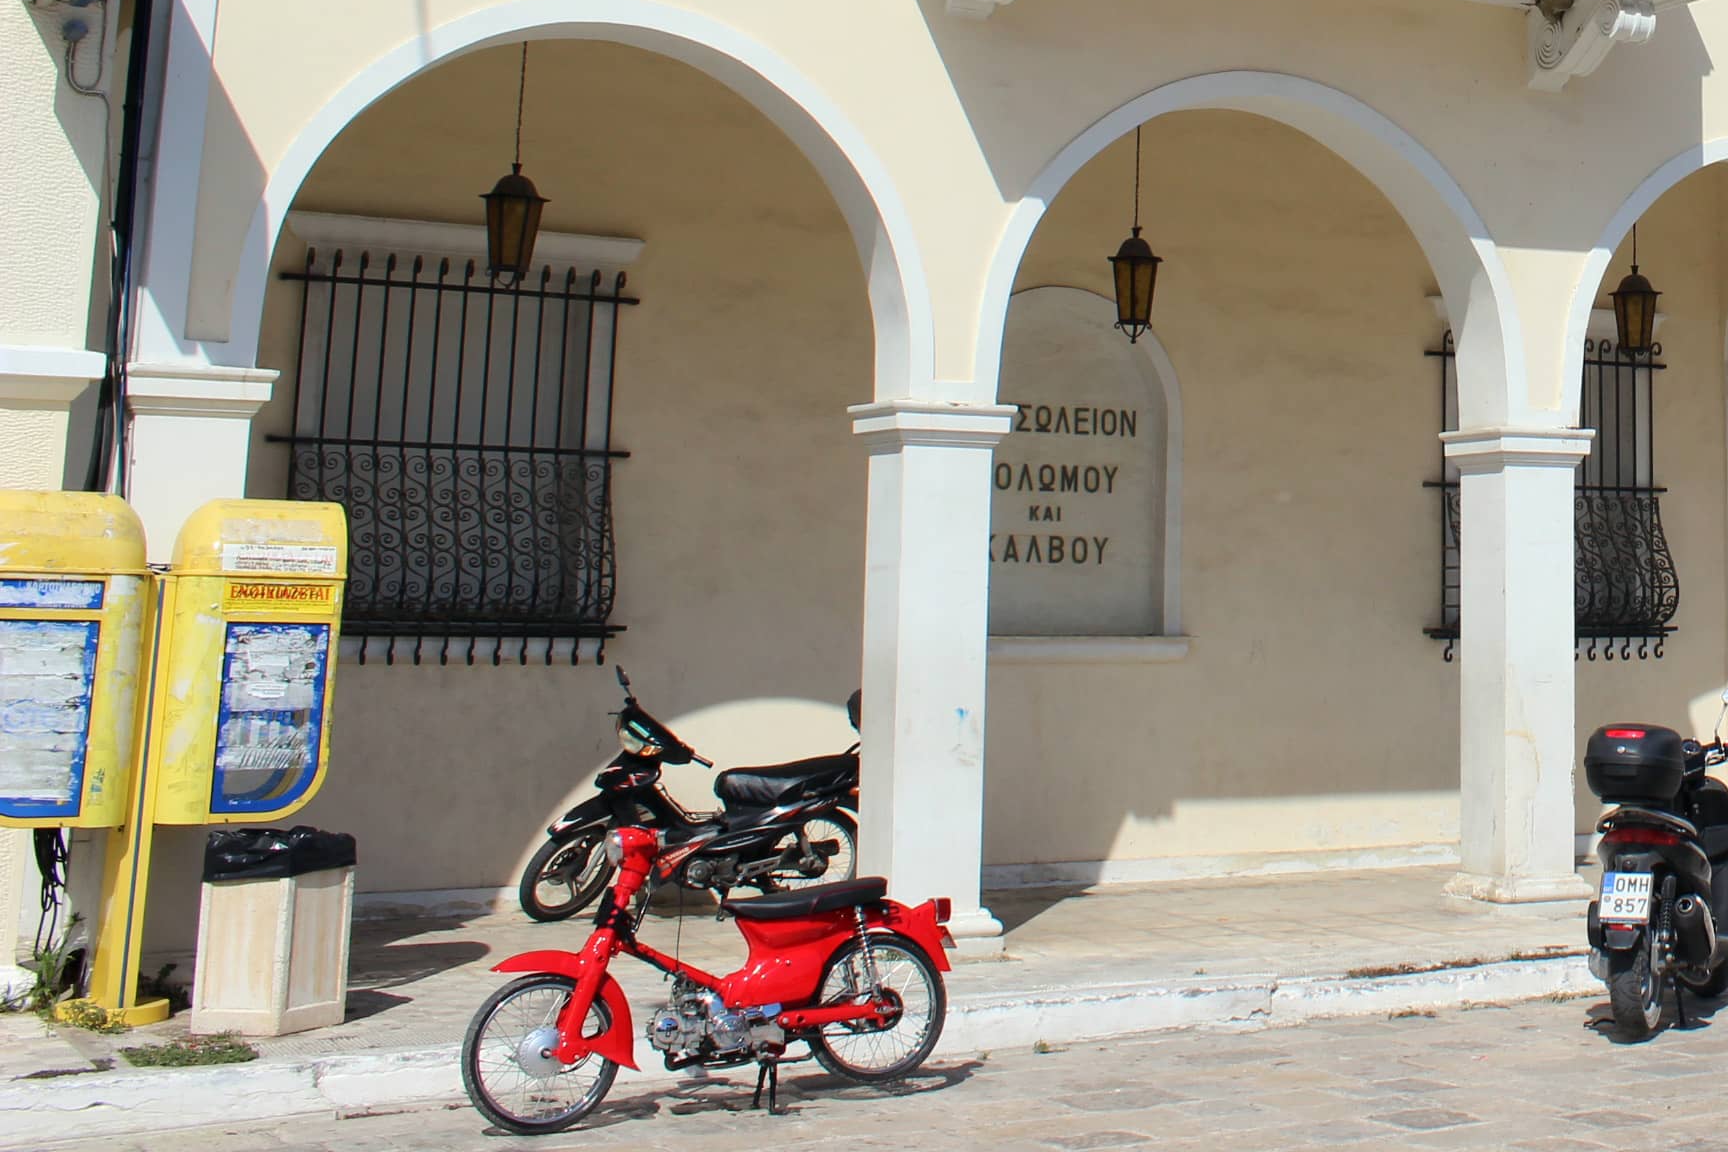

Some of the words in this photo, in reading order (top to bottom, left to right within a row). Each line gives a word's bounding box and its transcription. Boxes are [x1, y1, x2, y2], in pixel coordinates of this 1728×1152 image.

[1016, 404, 1137, 438] ΣΩΛΕΙΟΝ
[995, 462, 1119, 494] ΟΛΩΜΟΥ
[1028, 505, 1062, 522] ΚΑΙ
[1615, 877, 1649, 893] OMH
[1613, 898, 1648, 914] 857
